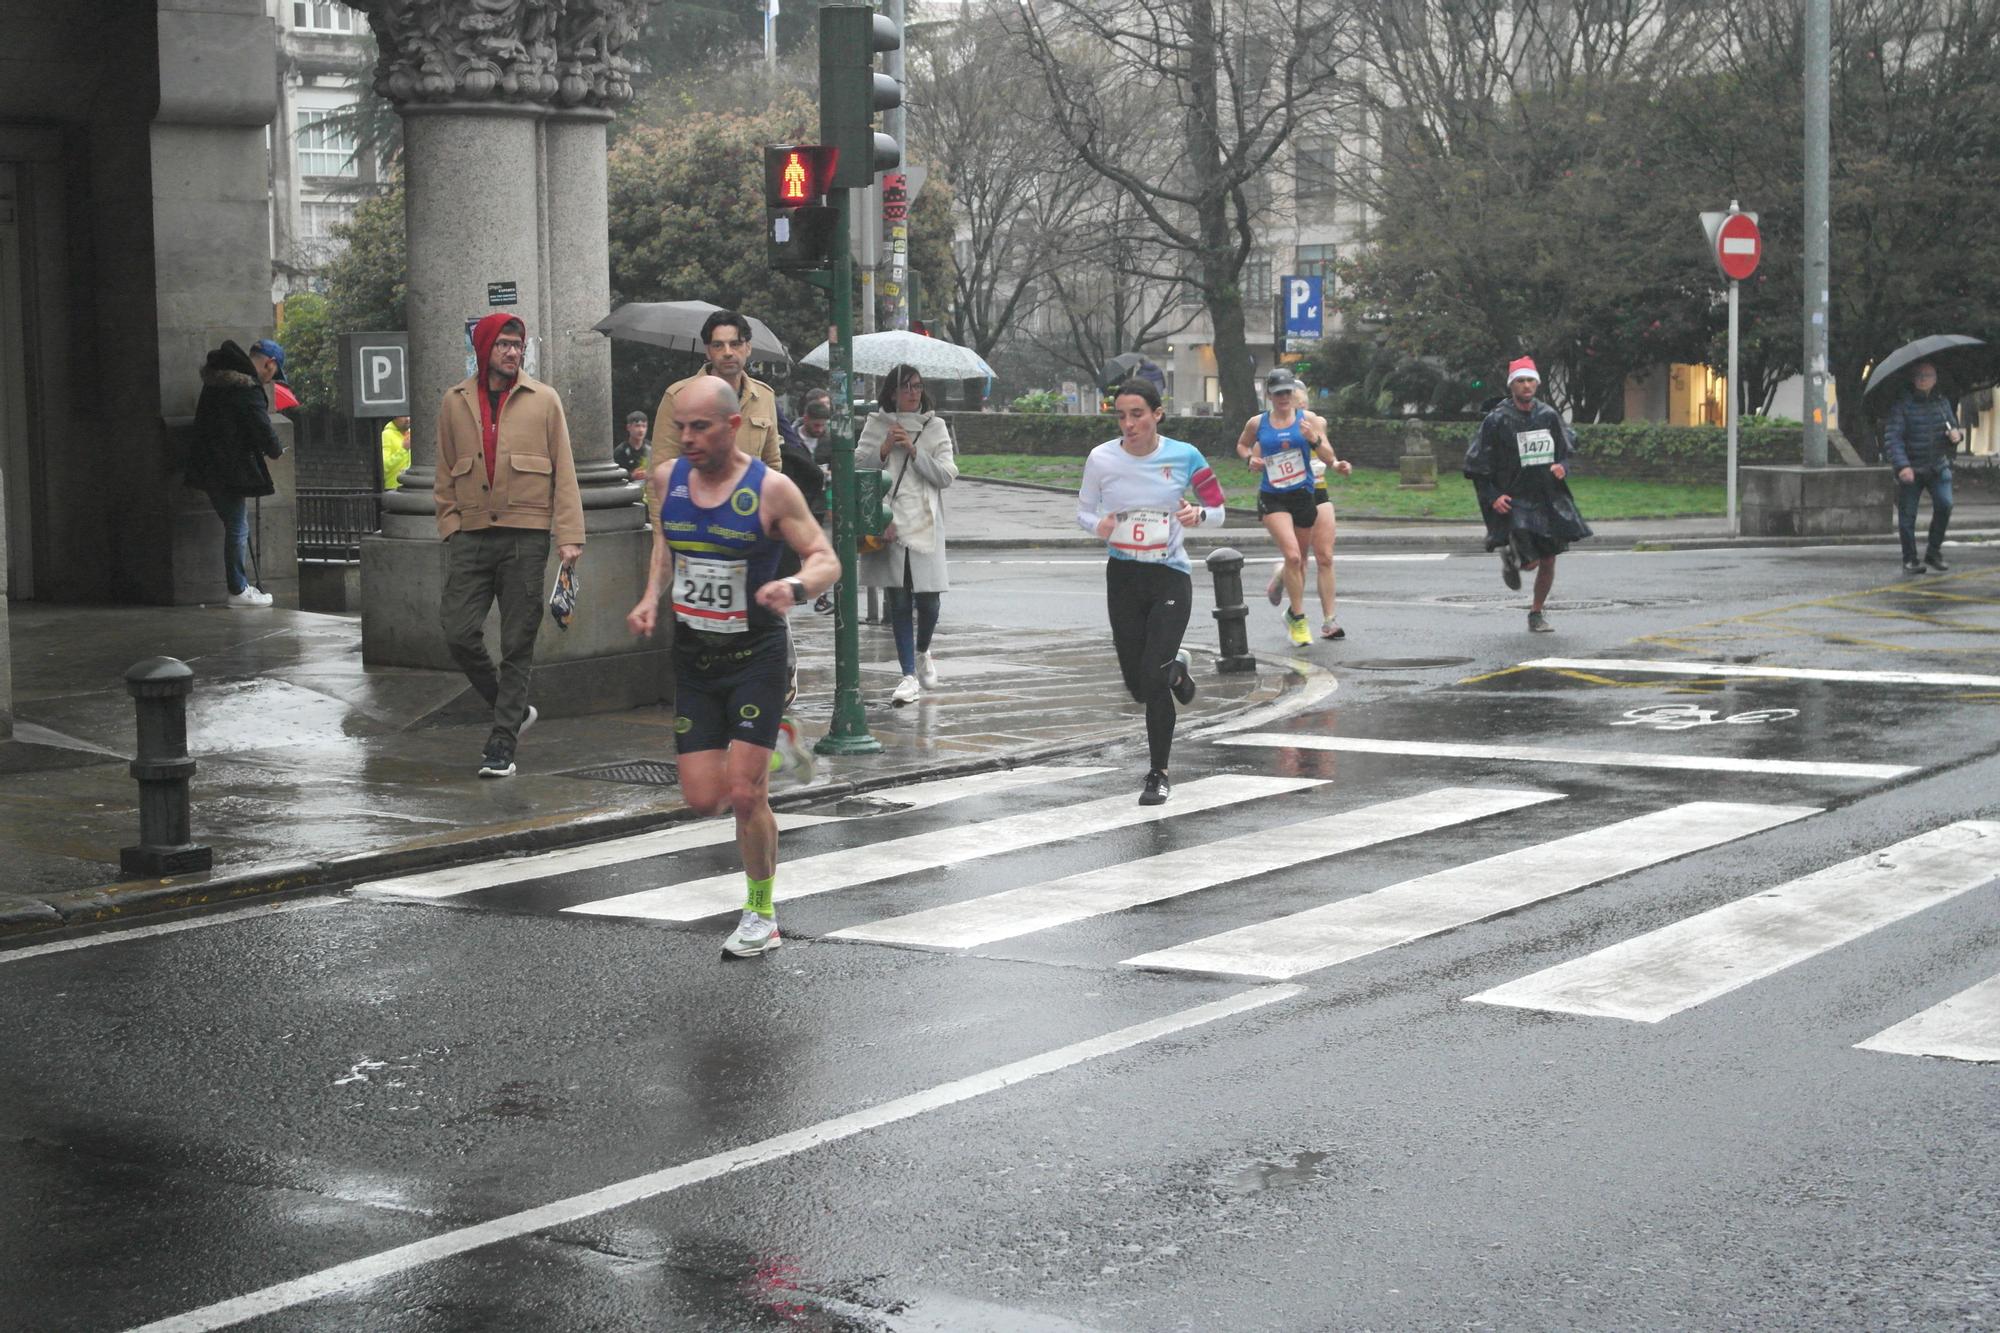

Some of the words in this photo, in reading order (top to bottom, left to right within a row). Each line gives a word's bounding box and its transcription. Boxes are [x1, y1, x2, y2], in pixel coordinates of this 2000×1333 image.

[1291, 280, 1310, 318] P
[373, 356, 391, 393] P
[1523, 440, 1551, 454] 1477
[1278, 461, 1294, 475] 18
[1133, 523, 1145, 542] 6
[684, 580, 732, 608] 249
